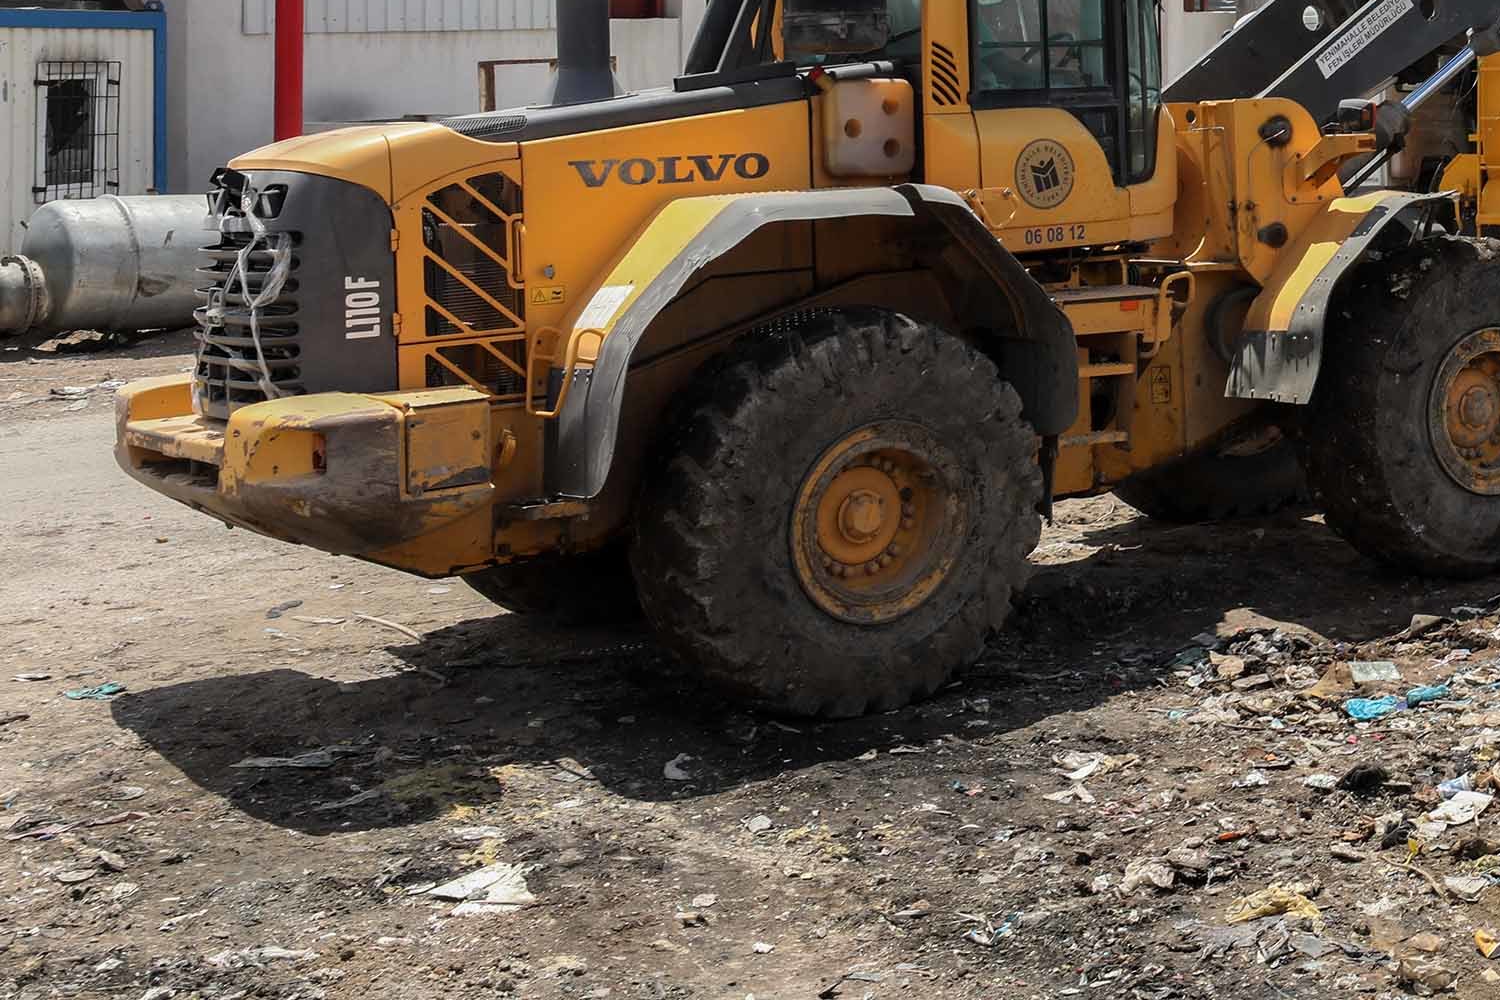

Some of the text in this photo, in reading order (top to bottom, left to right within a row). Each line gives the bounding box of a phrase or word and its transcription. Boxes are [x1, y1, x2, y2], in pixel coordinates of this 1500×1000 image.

[1327, 57, 1342, 72] FEN
[568, 152, 770, 187] VOLVO
[1025, 225, 1085, 245] 06 08 12
[345, 276, 380, 339] L110F
